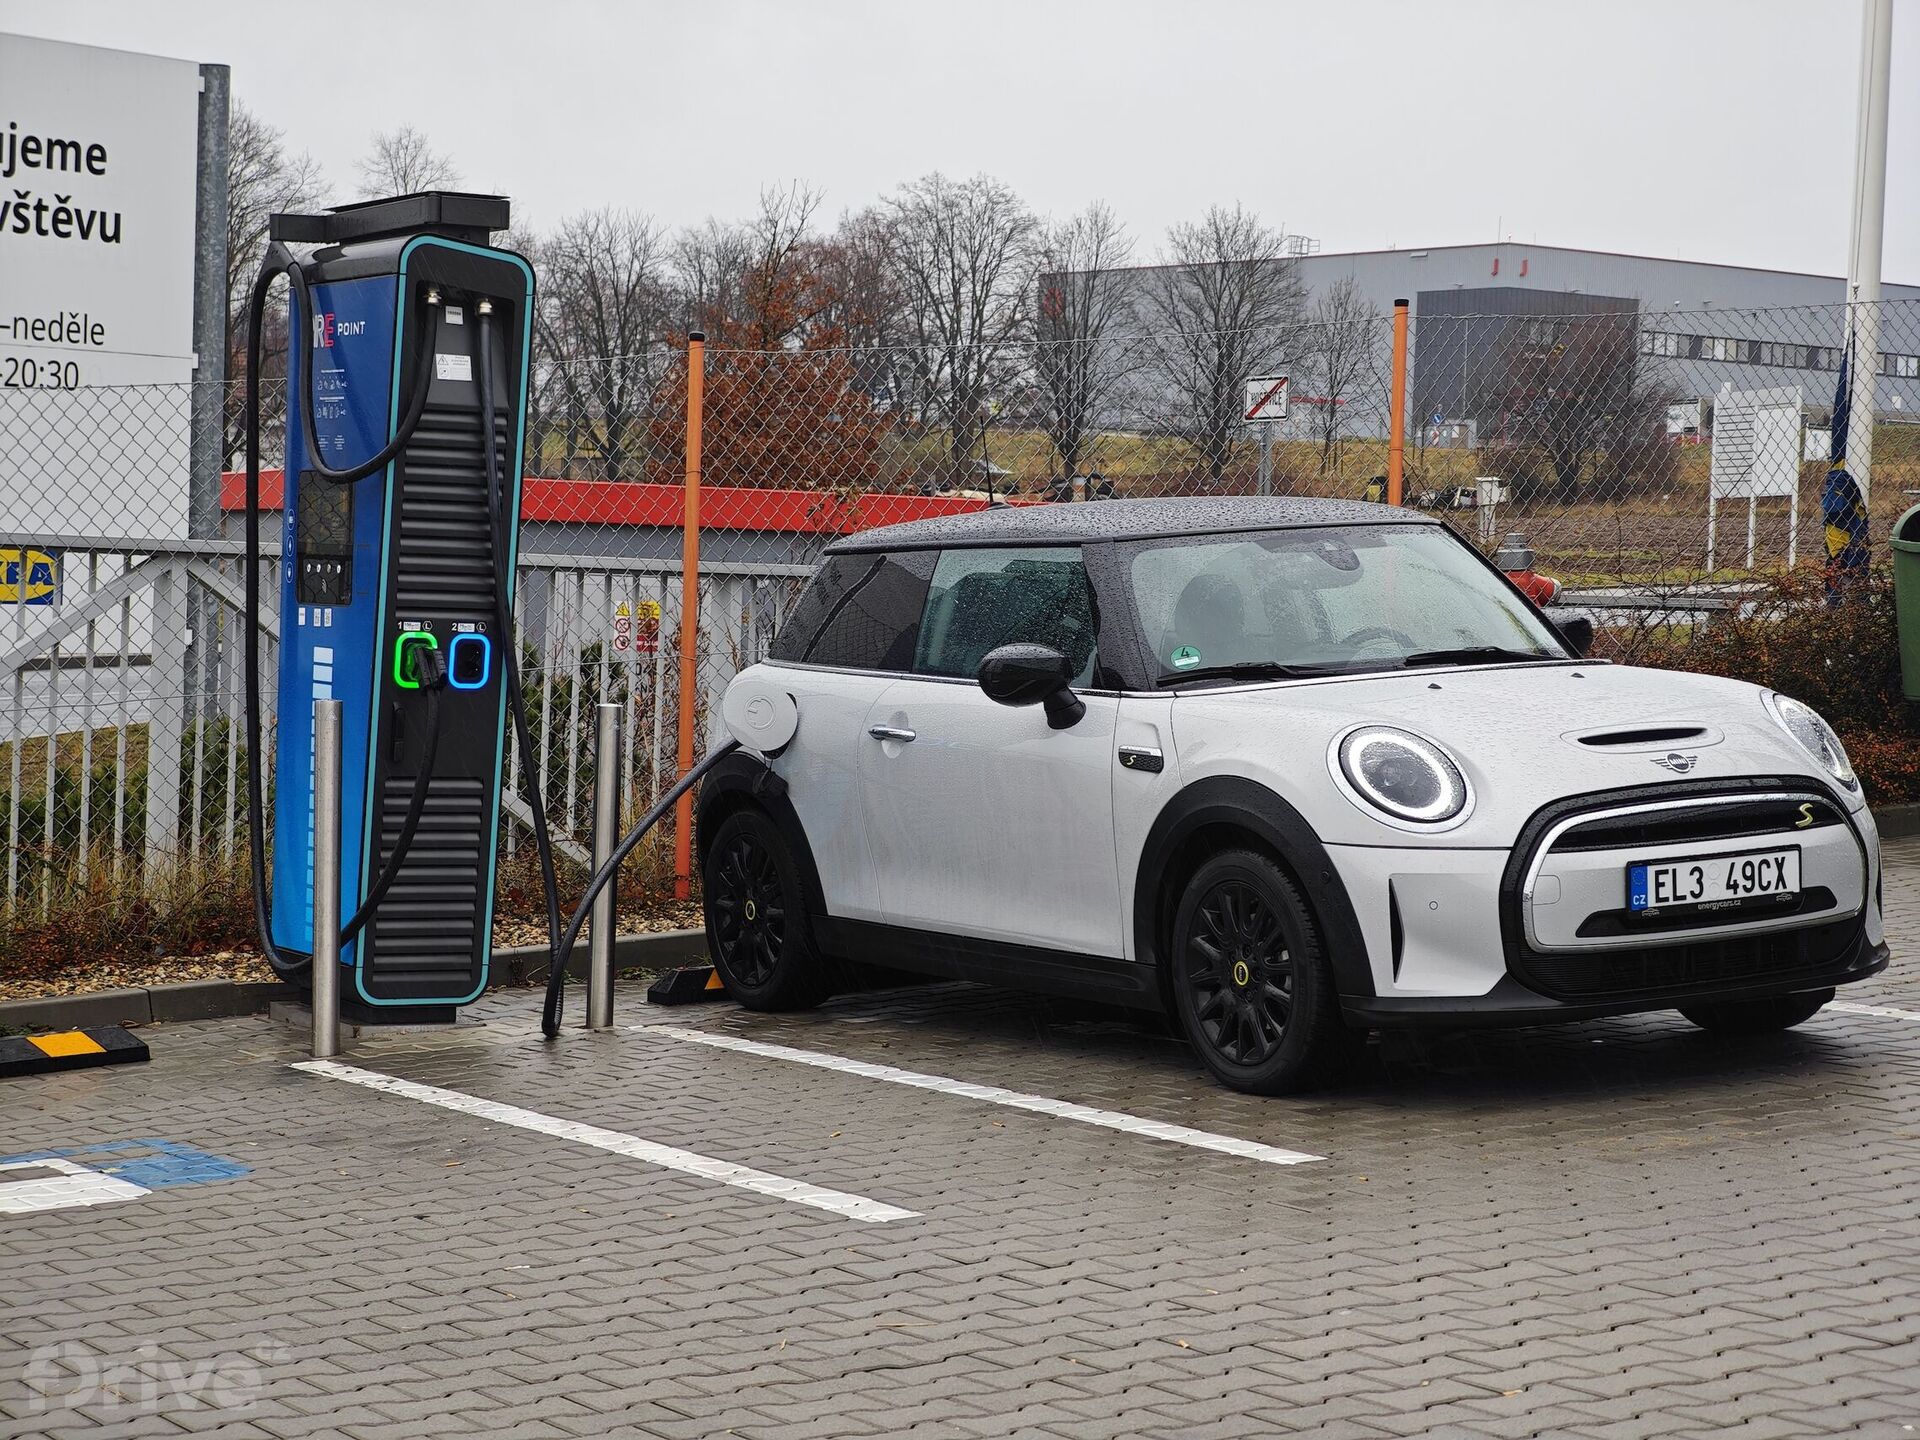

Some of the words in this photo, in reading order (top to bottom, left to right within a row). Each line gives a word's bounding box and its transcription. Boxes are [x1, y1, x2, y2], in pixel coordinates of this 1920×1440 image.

[0, 121, 107, 178] jeme
[313, 312, 335, 349] RE
[337, 320, 366, 337] POINT
[0, 561, 55, 586] EA
[1181, 647, 1190, 658] 4
[1795, 802, 1814, 828] S
[1654, 865, 1704, 904] EL3
[1725, 856, 1788, 895] 49CX
[1633, 894, 1647, 906] CZ
